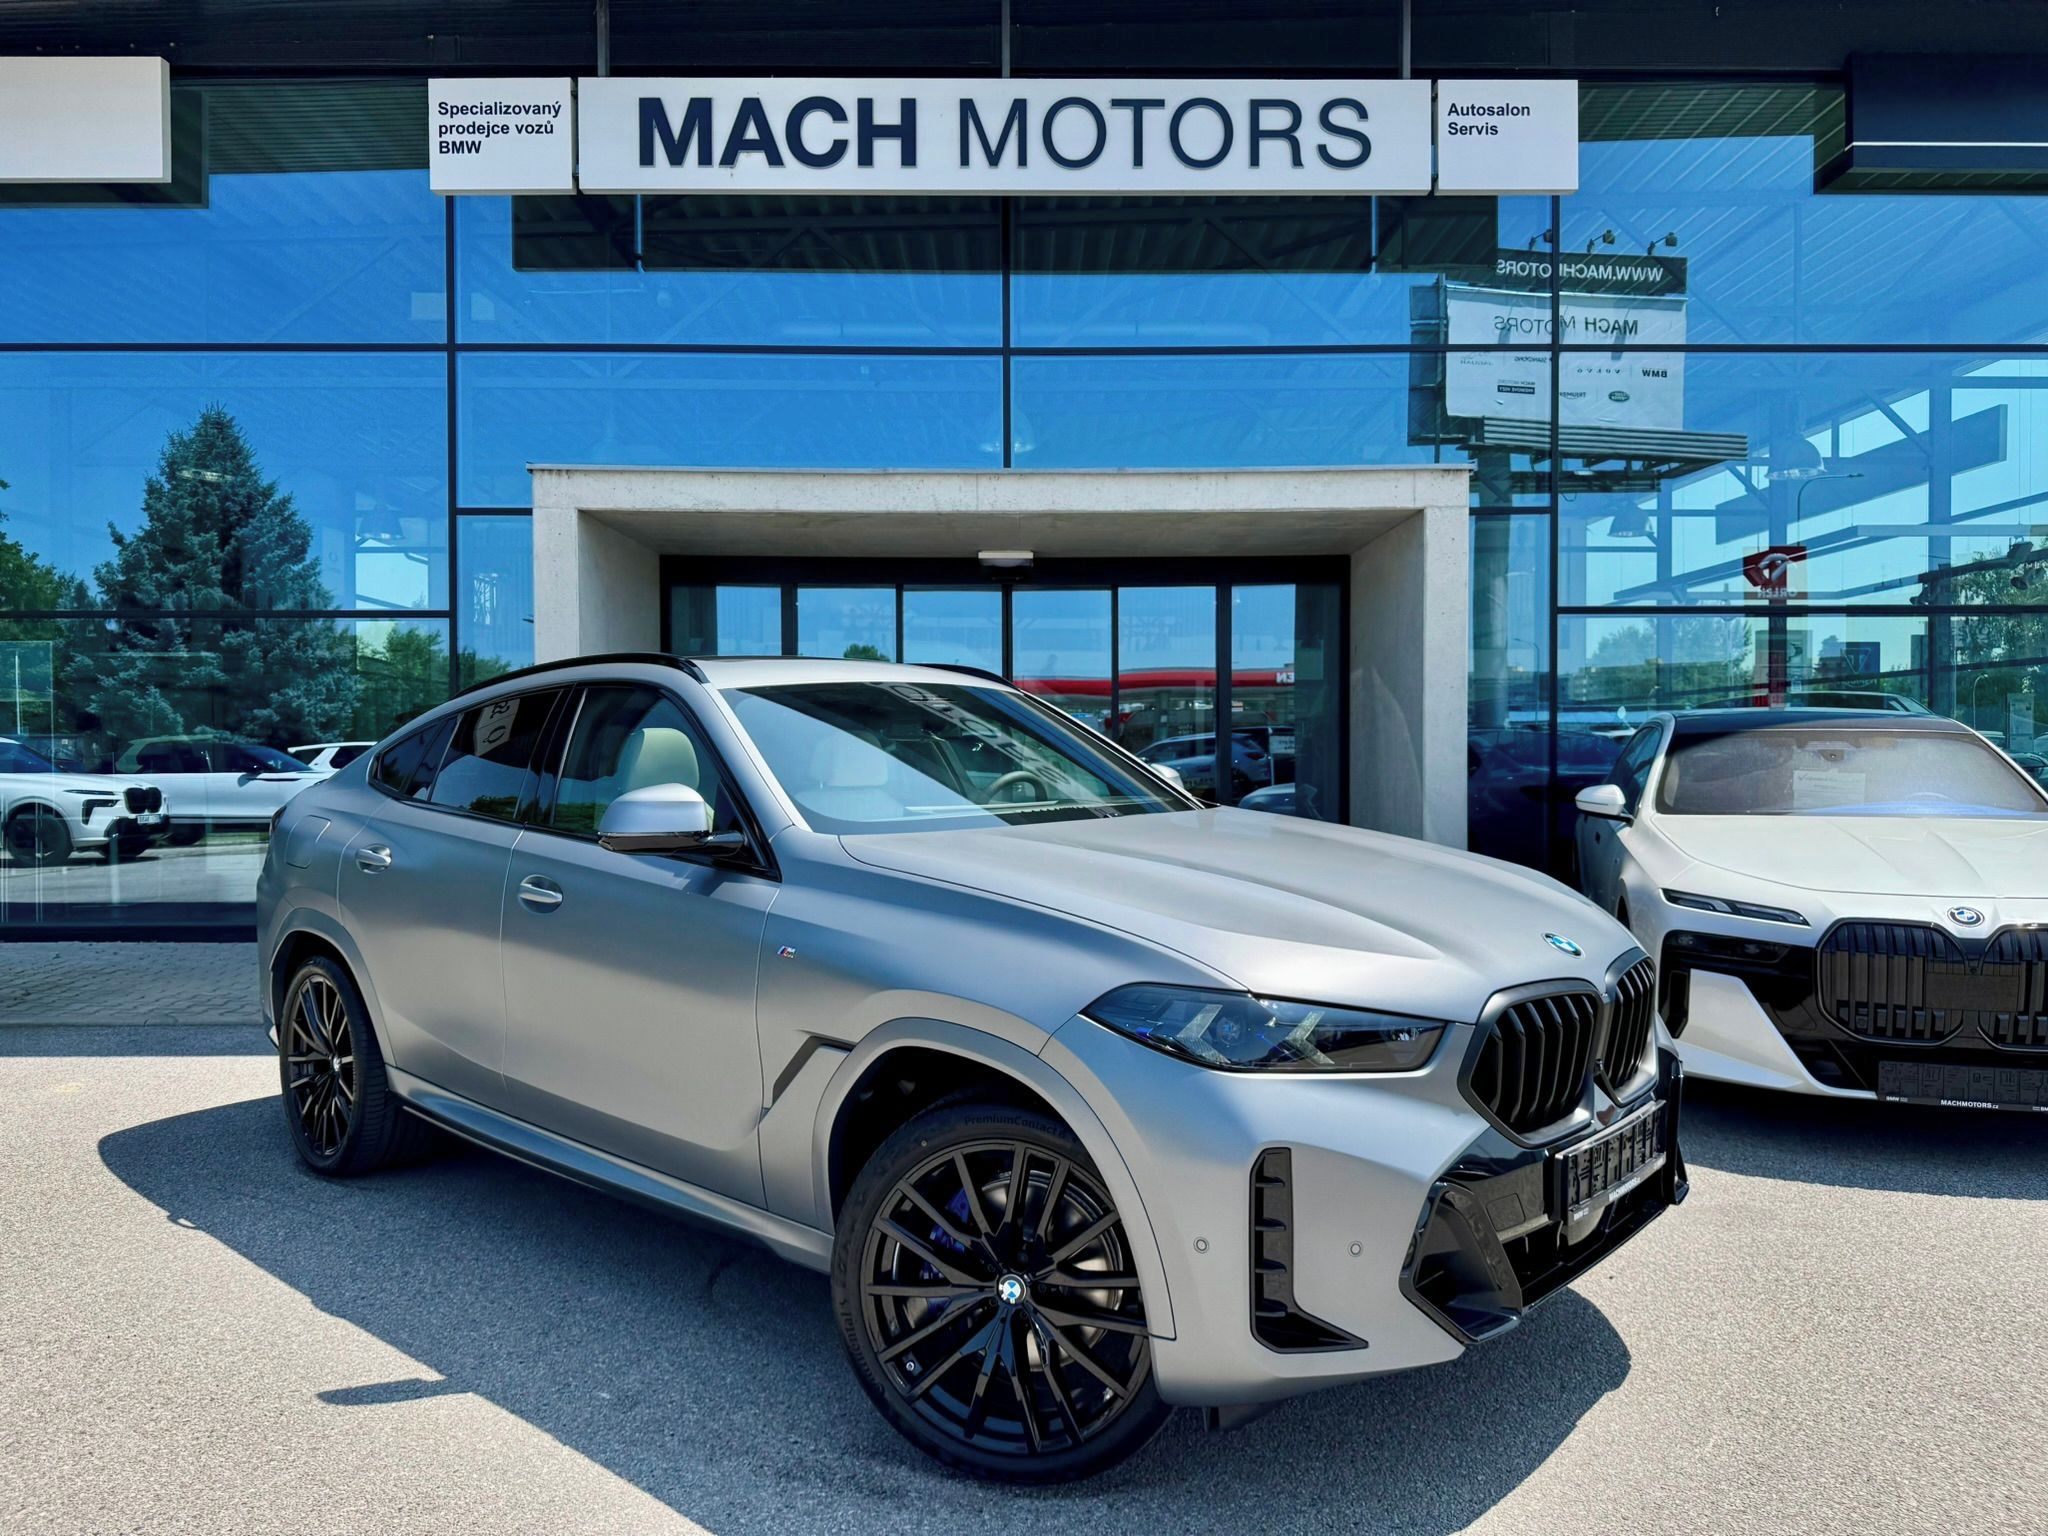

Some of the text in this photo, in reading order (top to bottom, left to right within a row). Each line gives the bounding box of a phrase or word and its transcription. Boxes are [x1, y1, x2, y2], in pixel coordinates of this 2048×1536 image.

[437, 100, 562, 119] Specializovaný
[1447, 102, 1531, 117] Autosalon
[438, 119, 554, 138] prodejce vozů
[638, 95, 1372, 170] MACH MOTORS
[1447, 121, 1499, 136] Servis
[438, 140, 482, 155] BMW
